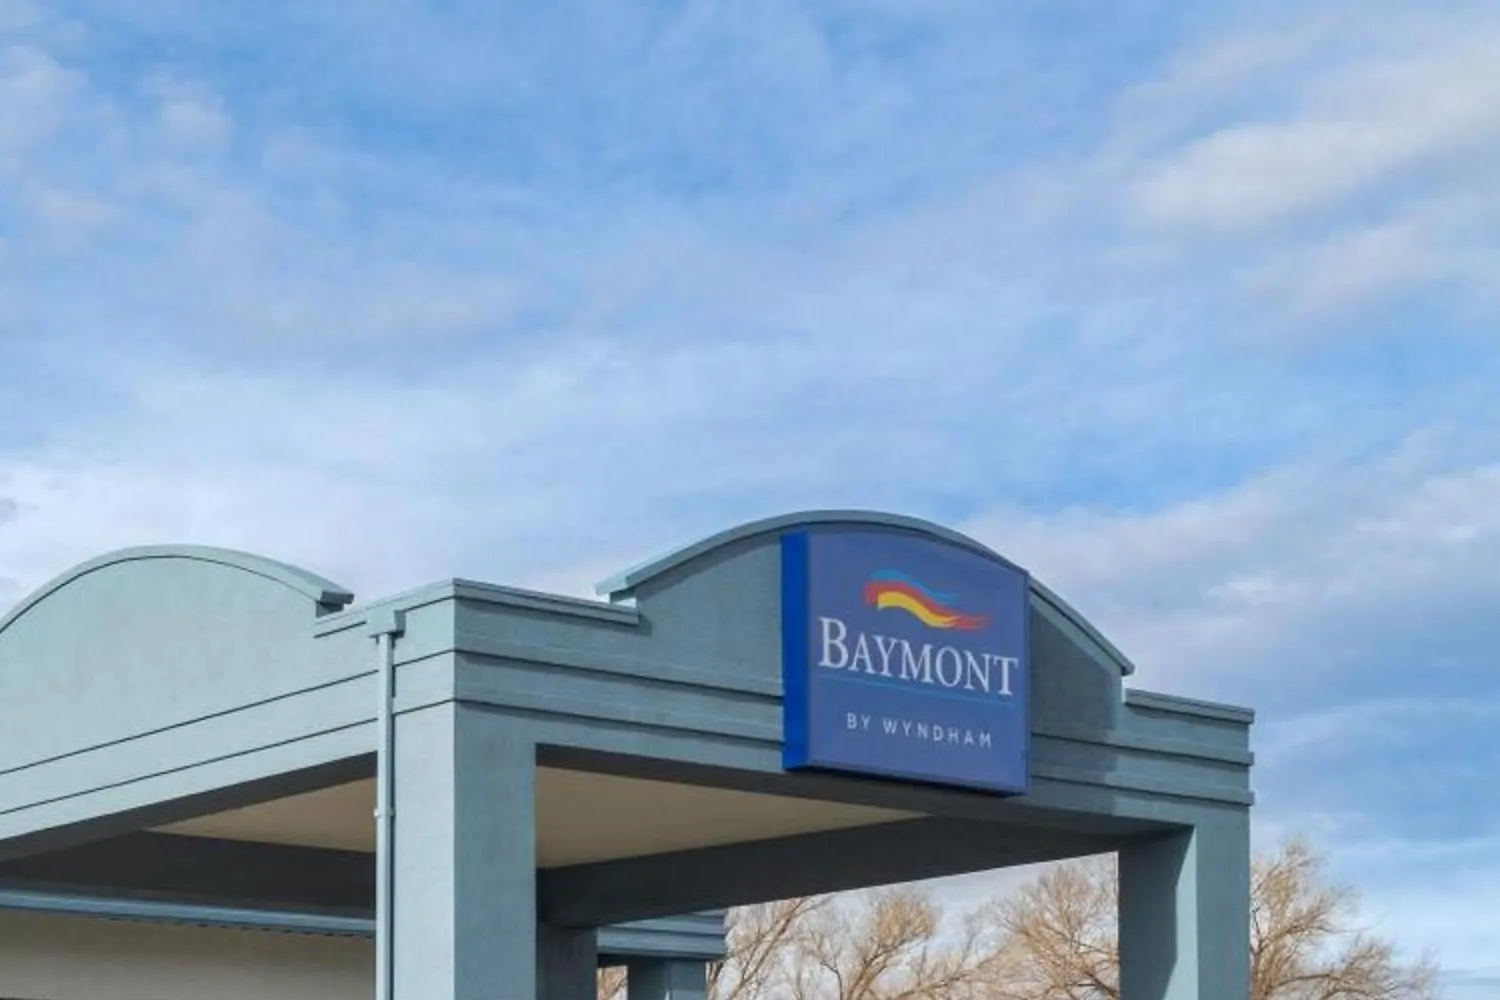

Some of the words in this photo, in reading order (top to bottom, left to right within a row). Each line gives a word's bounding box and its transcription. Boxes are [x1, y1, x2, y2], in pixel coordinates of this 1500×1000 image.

[818, 616, 1019, 696] BAYMONT
[846, 712, 871, 730] BY
[882, 717, 992, 748] WYNDHAM
